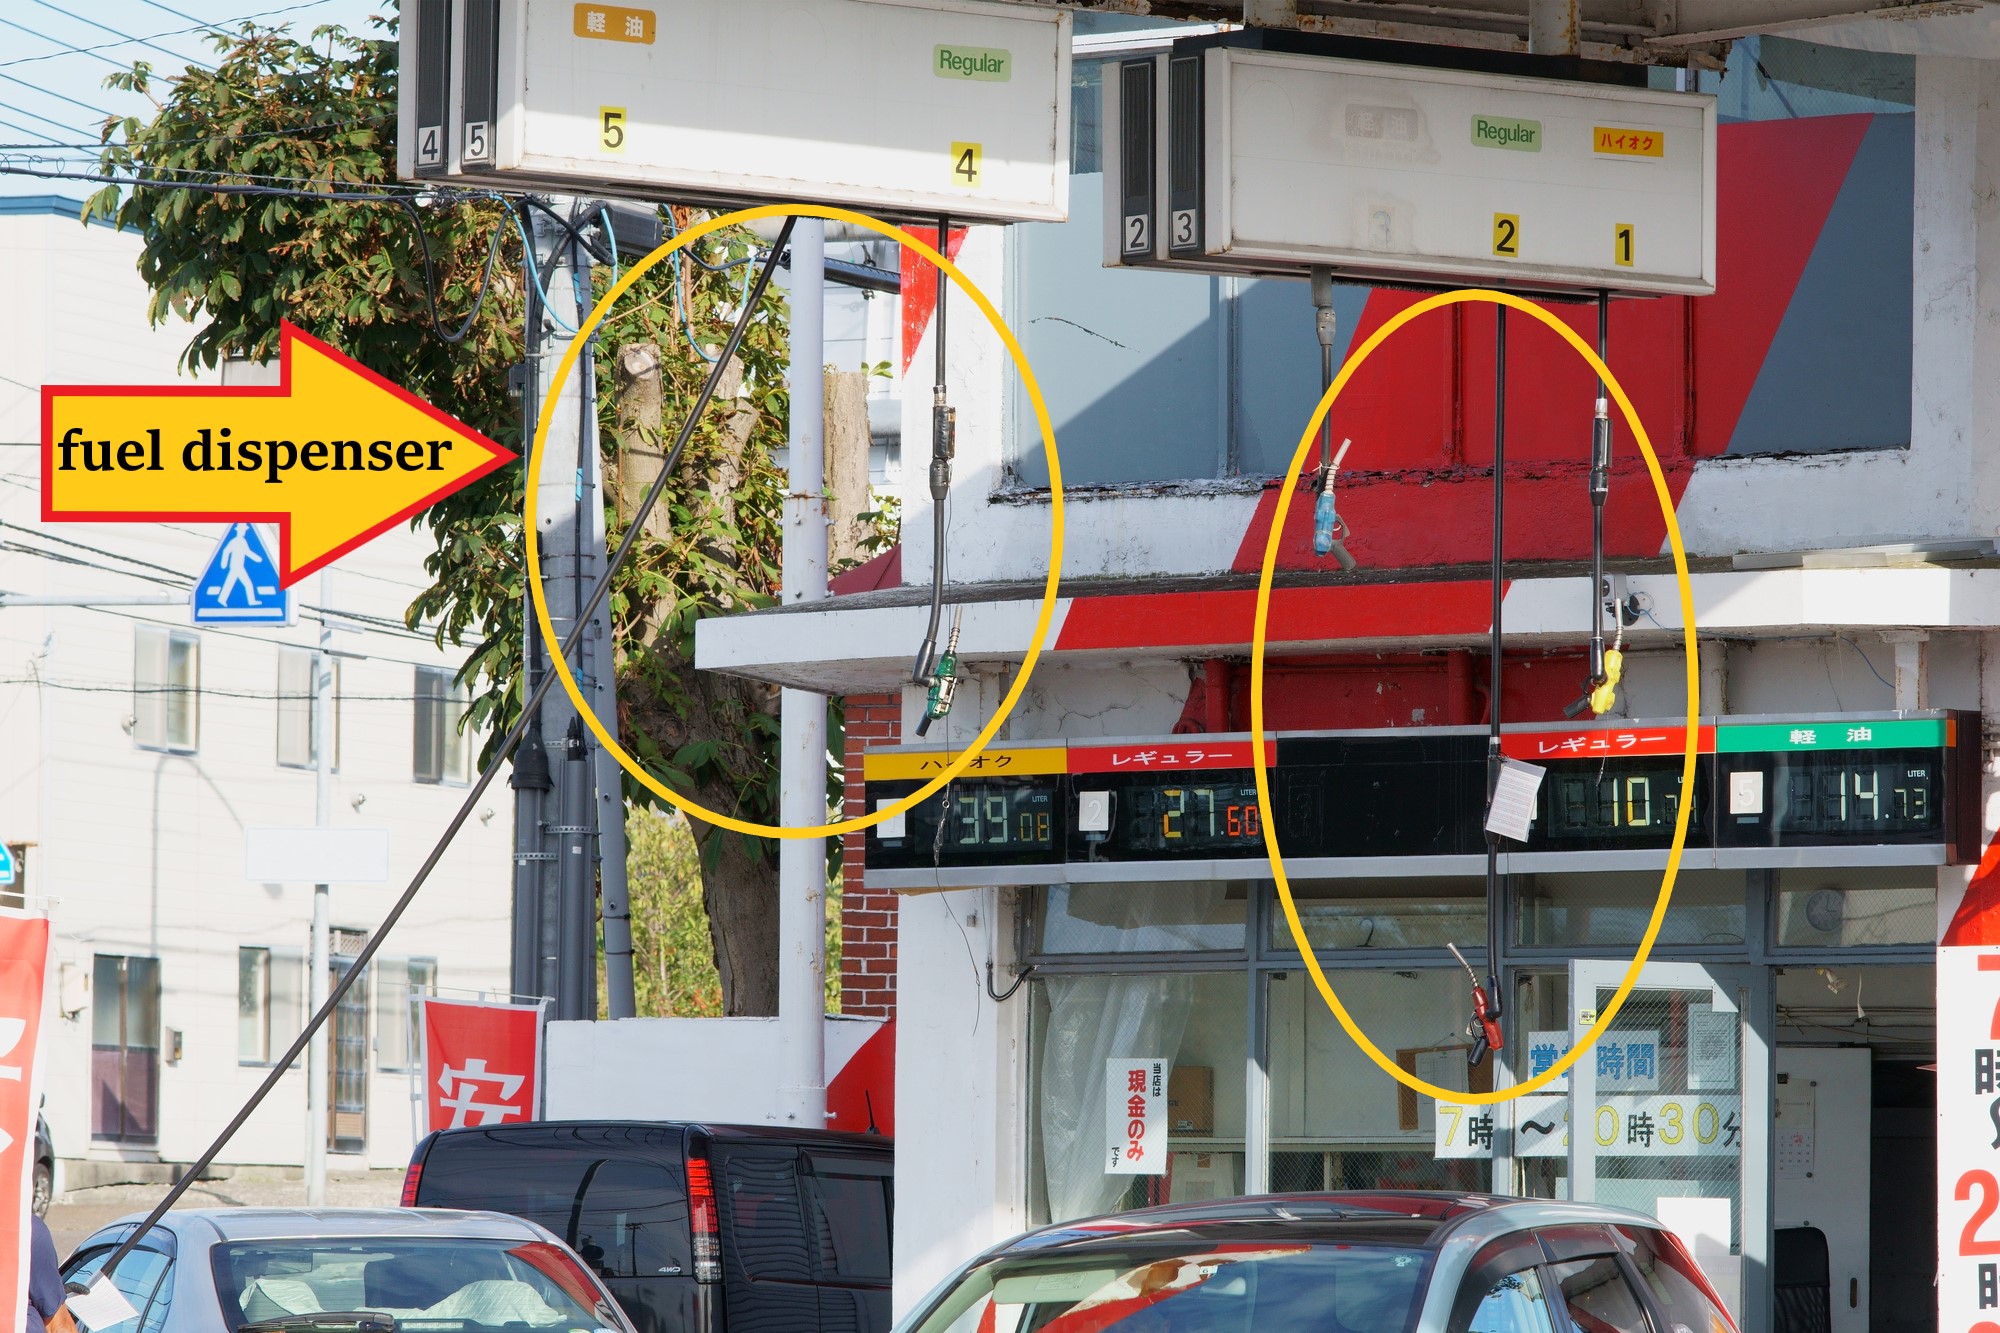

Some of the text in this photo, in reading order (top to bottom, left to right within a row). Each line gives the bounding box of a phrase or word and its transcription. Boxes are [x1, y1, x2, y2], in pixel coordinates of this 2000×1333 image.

[585, 10, 644, 39] 軽油
[939, 49, 1005, 76] Regular
[422, 130, 438, 160] 4
[469, 123, 485, 157] 5
[603, 111, 624, 149] 5
[1477, 119, 1536, 146] Regular
[1601, 133, 1654, 152] ハイオク
[955, 148, 977, 183] 4
[1130, 217, 1145, 249] 2
[1176, 212, 1193, 247] 3
[1496, 218, 1515, 253] 2
[1618, 229, 1630, 262] 1
[1538, 734, 1667, 754] レギュラー
[1789, 726, 1872, 745] 軽油
[1112, 750, 1233, 766] レギュラー
[1907, 769, 1926, 778] LITER
[1737, 778, 1756, 808] 5
[1087, 799, 1103, 828] 2
[1152, 1062, 1162, 1098] 当店は
[1126, 1069, 1147, 1161] 現金のみ
[1111, 1146, 1120, 1168] です
